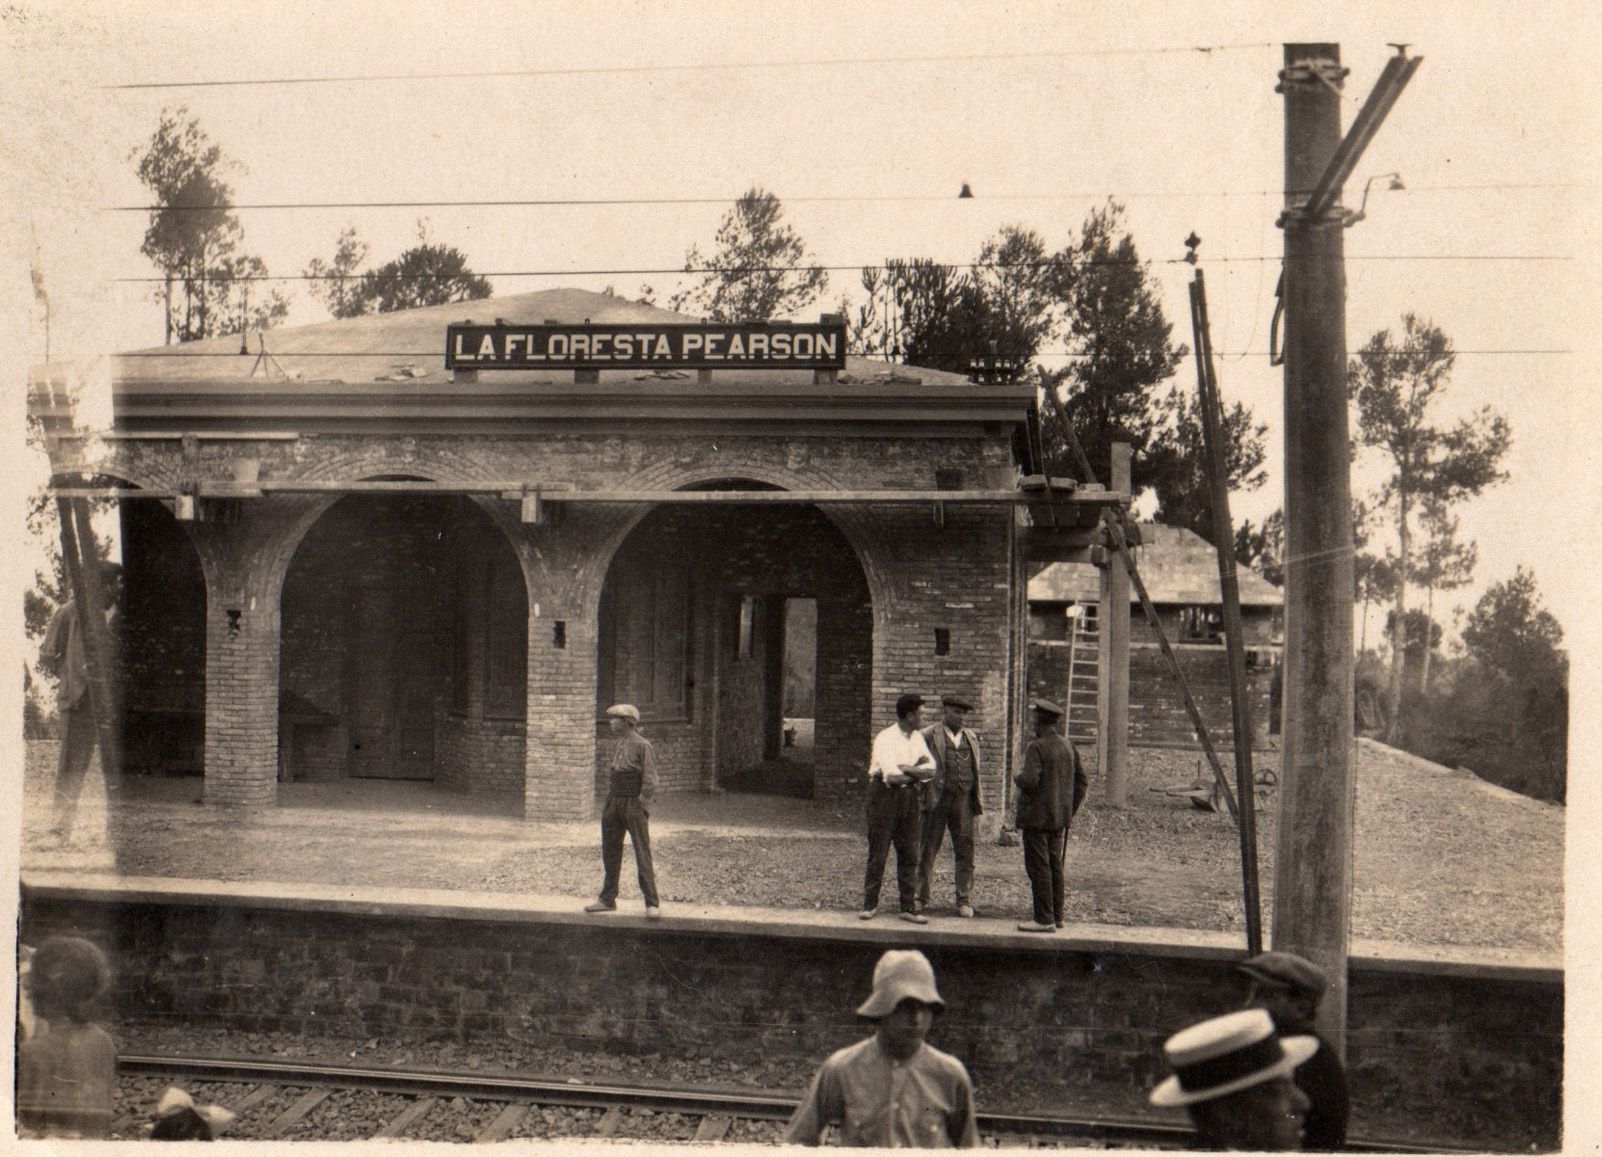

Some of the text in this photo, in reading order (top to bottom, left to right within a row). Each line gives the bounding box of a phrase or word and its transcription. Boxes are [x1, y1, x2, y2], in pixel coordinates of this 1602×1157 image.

[455, 333, 837, 360] LA FLORESTA PEARSON
